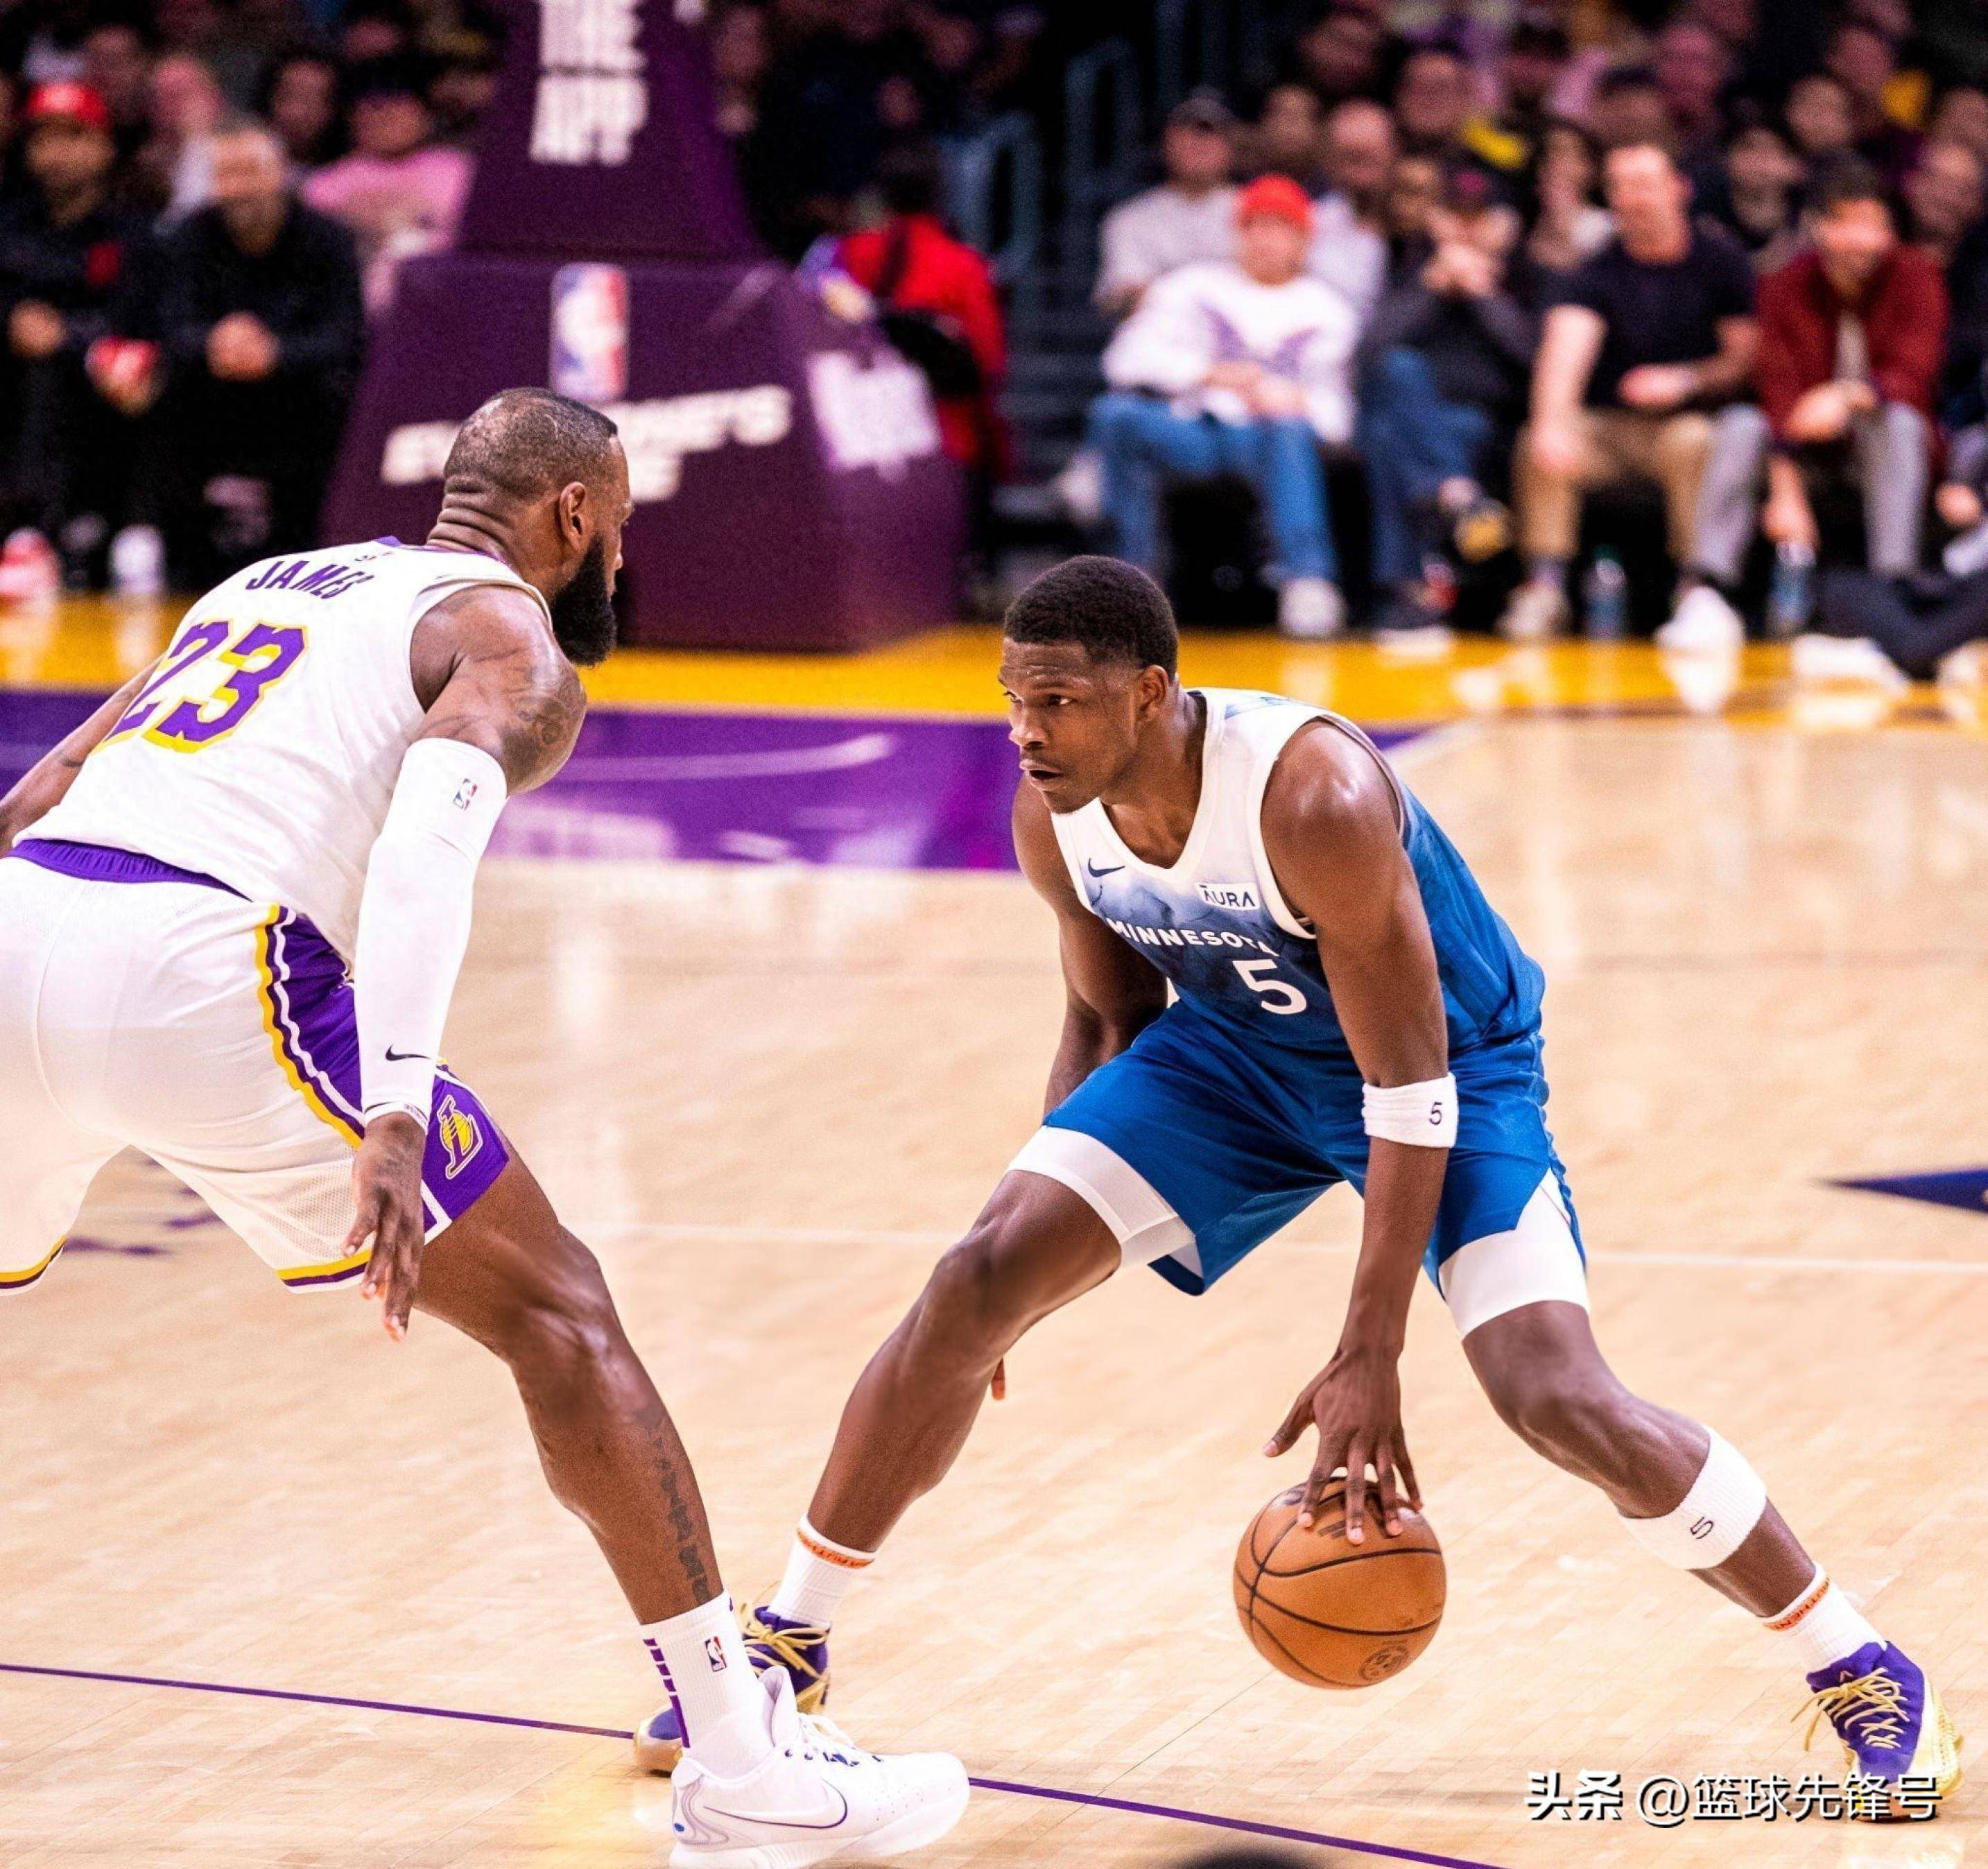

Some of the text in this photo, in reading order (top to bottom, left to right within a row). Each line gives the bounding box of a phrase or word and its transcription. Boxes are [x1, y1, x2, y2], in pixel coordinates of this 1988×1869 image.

[245, 560, 374, 599] JAMES
[87, 617, 309, 754] 23
[1106, 918, 1281, 957] MINNESOTA
[1231, 958, 1307, 1015] 5
[1428, 1101, 1443, 1126] 5
[1689, 1516, 1714, 1540] 5
